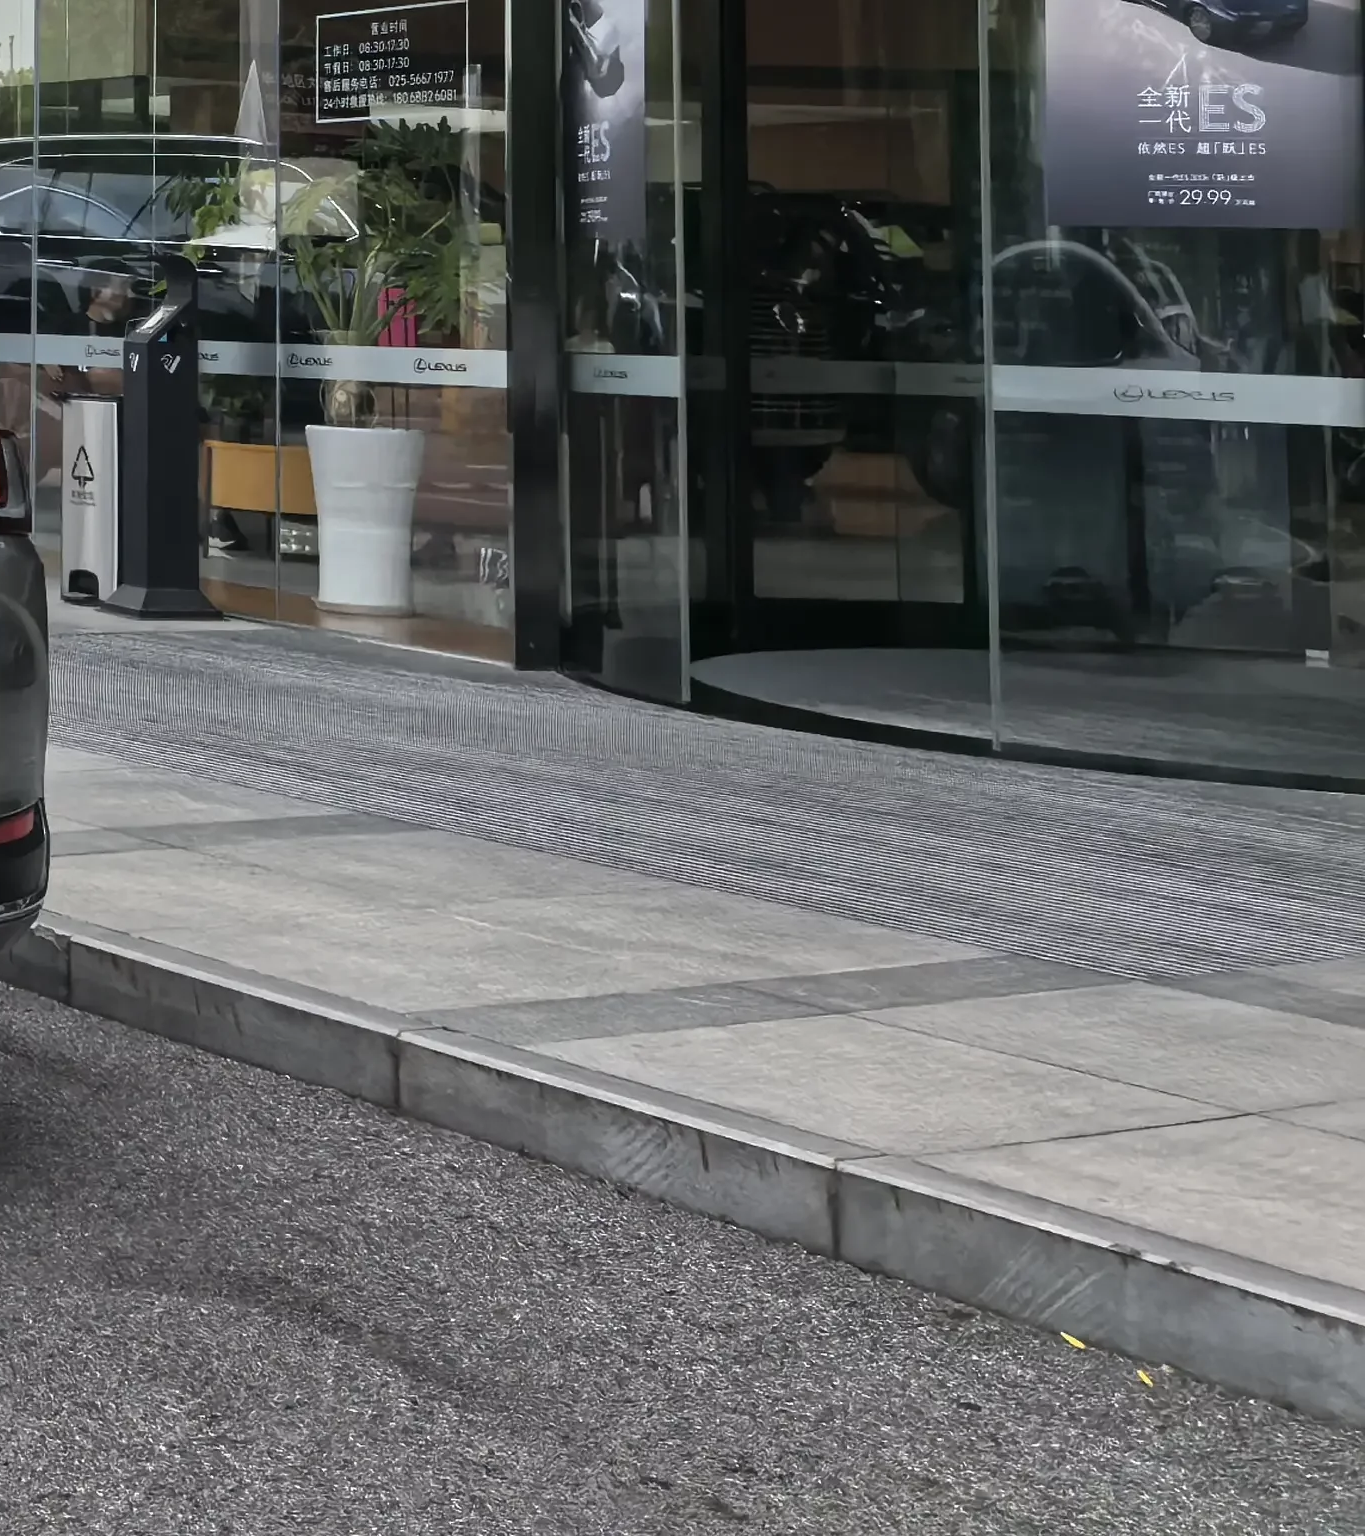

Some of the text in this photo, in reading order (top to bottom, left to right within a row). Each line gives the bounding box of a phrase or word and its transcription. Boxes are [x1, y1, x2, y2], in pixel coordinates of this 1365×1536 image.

[1137, 83, 1267, 133] 全新 ES
[1138, 110, 1192, 133] 一代
[1179, 189, 1232, 205] 29.99
[428, 362, 468, 373] LEXUS
